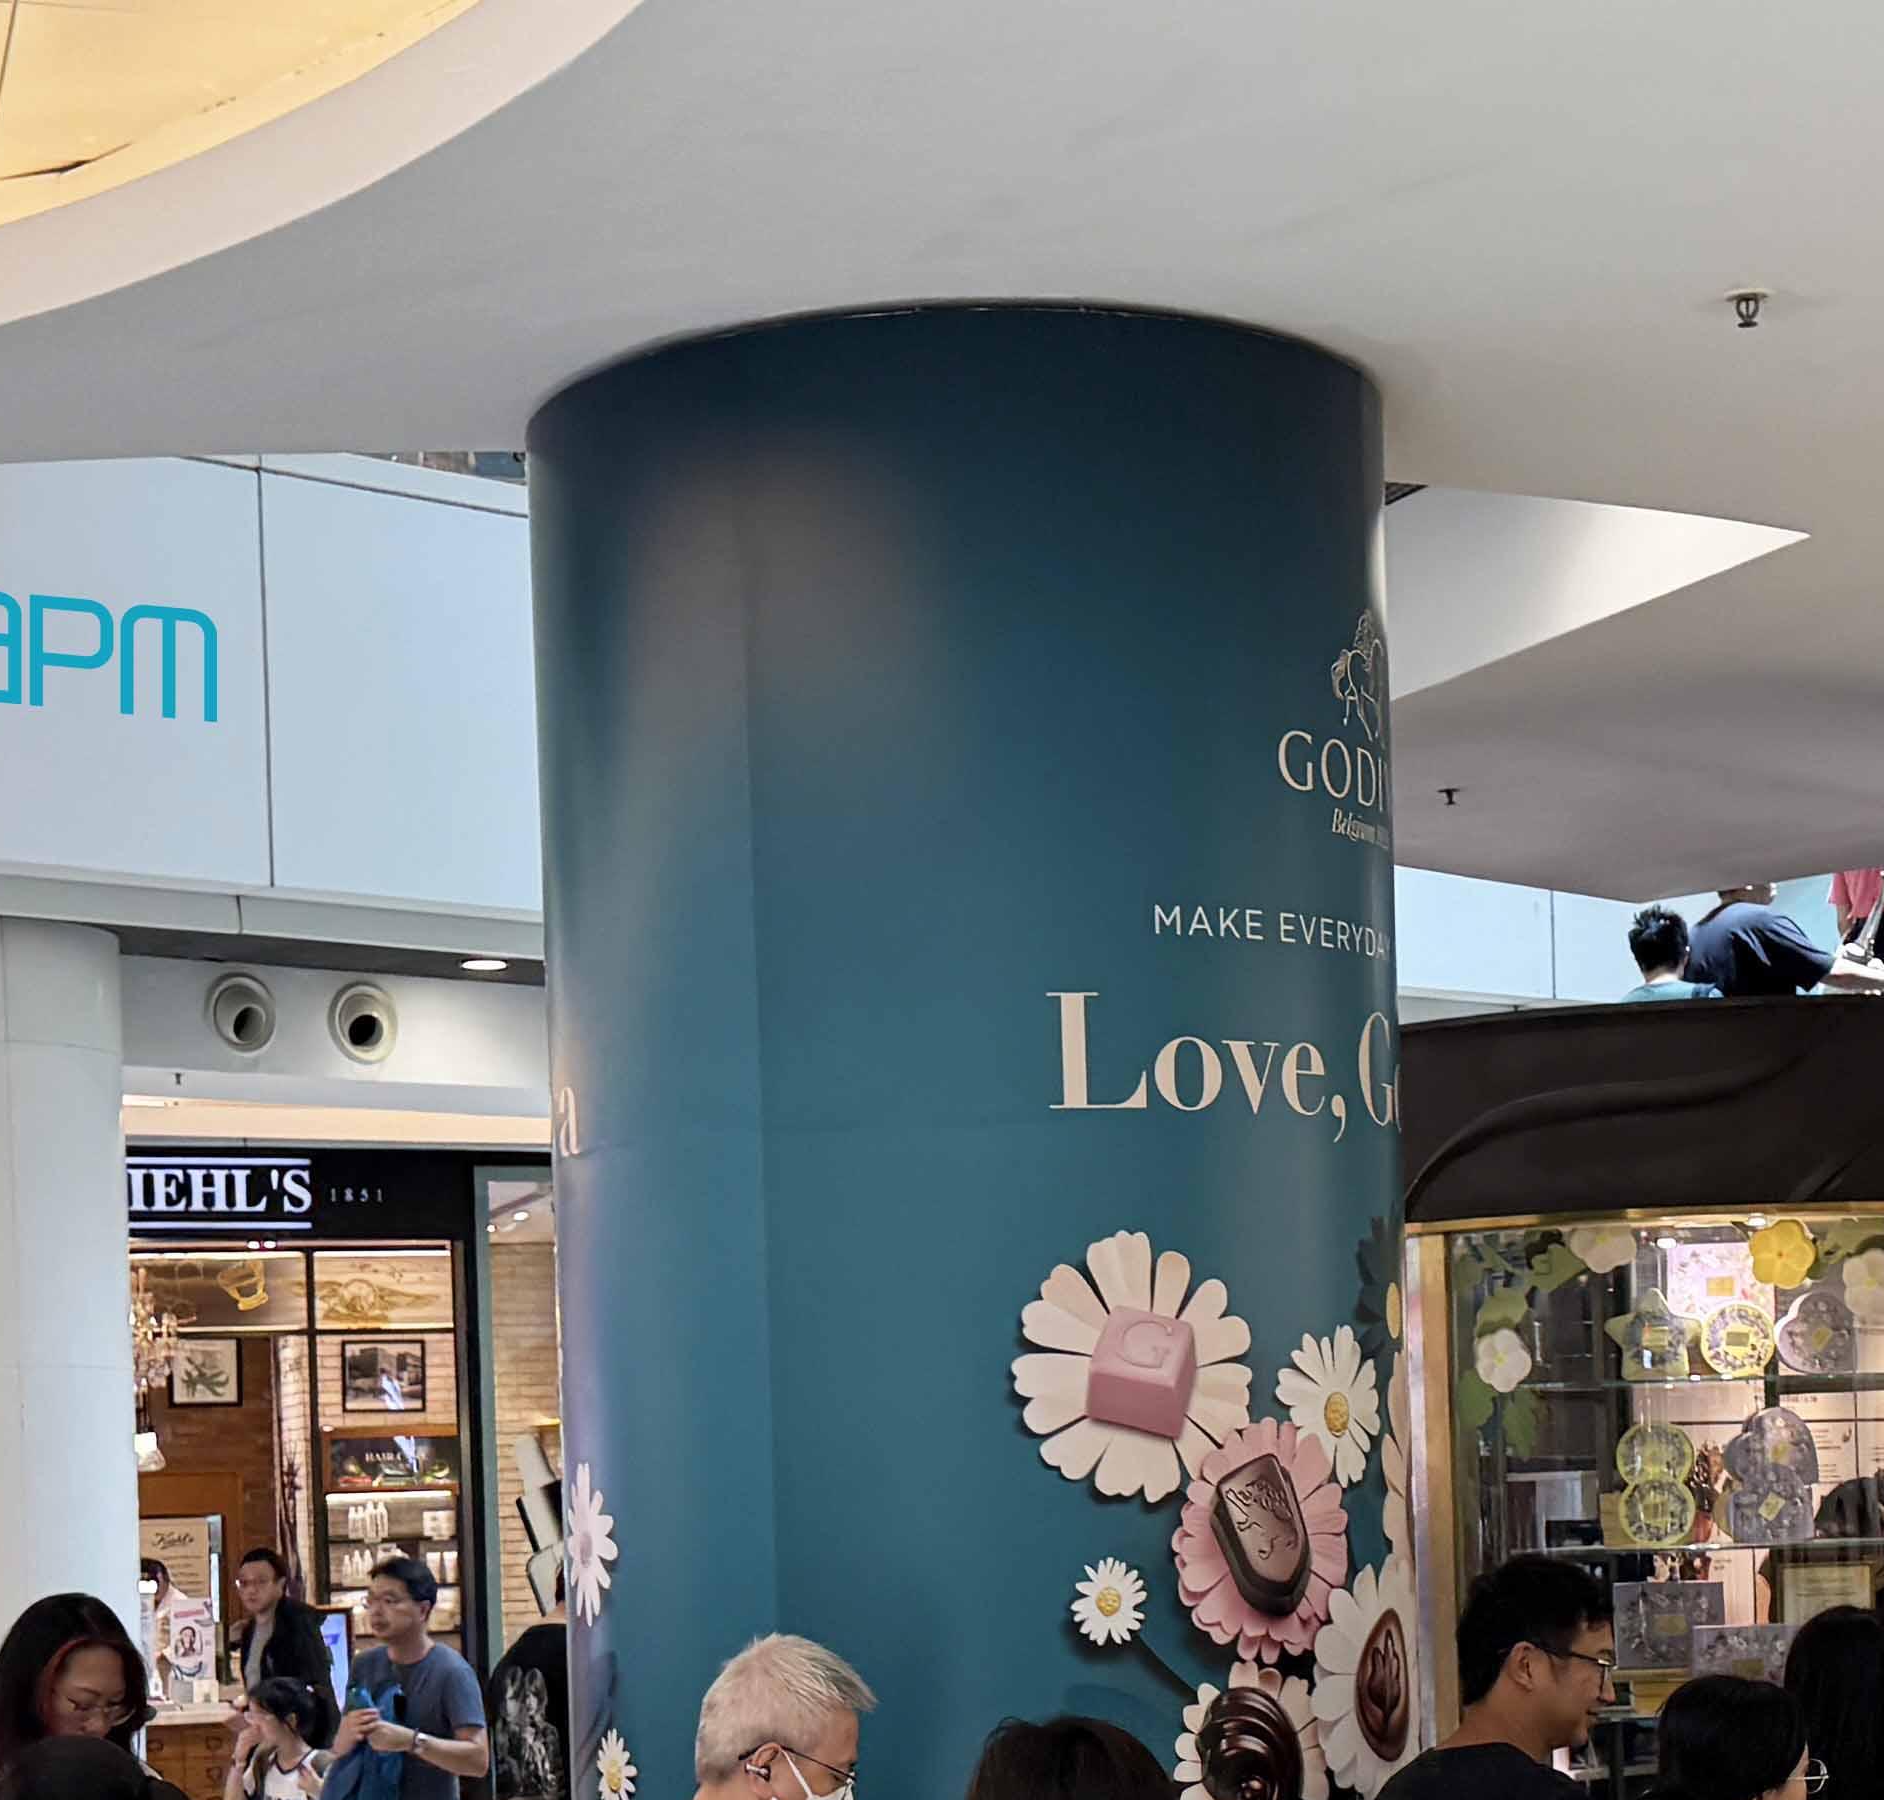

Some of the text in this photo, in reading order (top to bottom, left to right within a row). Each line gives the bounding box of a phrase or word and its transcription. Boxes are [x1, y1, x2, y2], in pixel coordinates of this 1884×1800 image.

[1278, 730, 1386, 812] GODI
[1153, 904, 1264, 940] MAKE
[1045, 991, 1346, 1142] Love,
[126, 1168, 384, 1213] IEHL'S 1851
